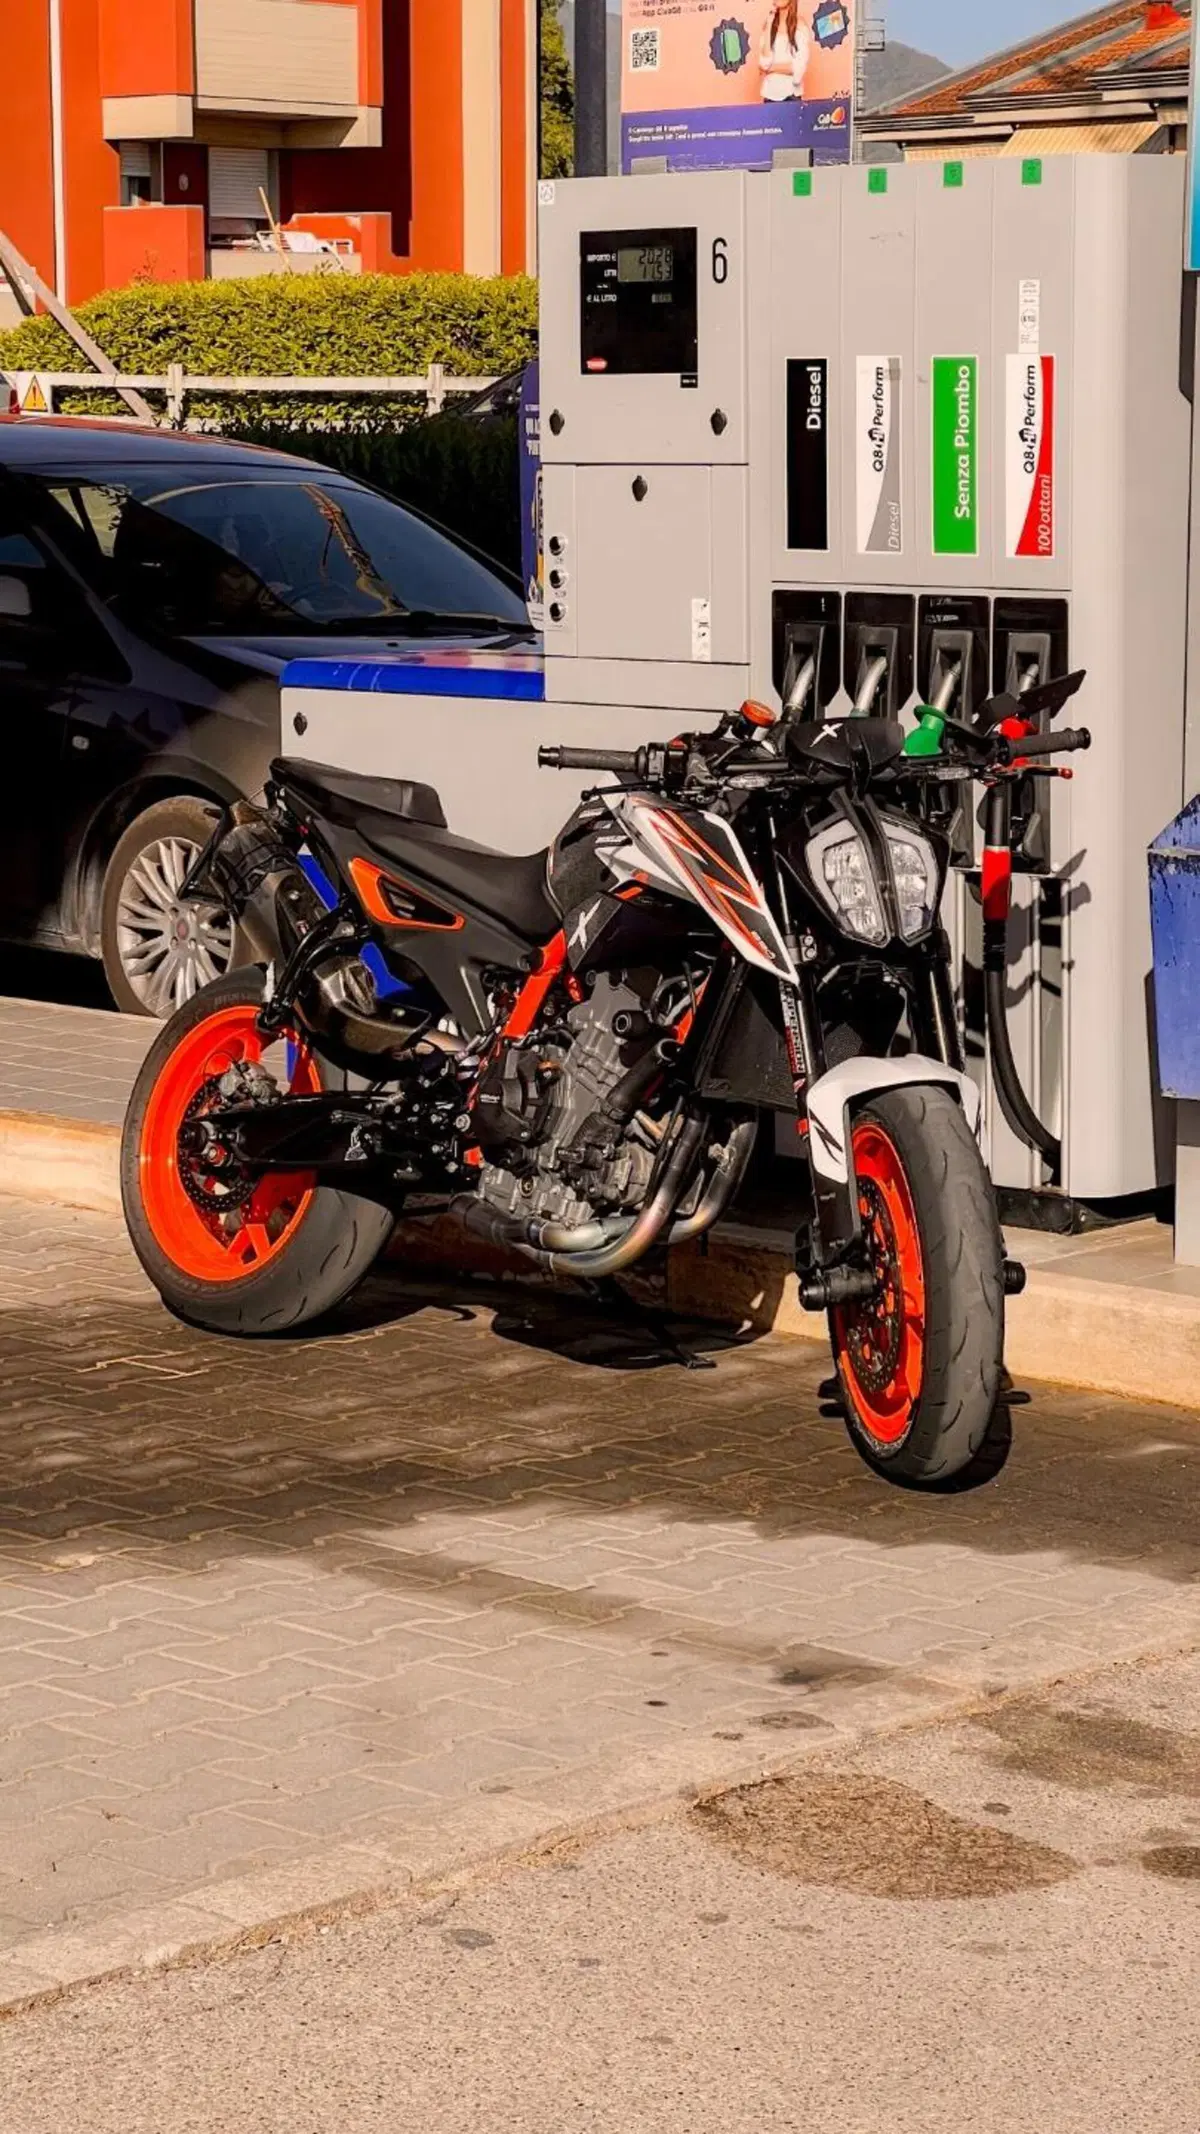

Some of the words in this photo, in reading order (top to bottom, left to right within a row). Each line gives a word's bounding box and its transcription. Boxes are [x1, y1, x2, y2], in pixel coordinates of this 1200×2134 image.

[712, 237, 728, 284] 6
[805, 365, 822, 431] Diesel
[872, 366, 885, 427] Perform
[954, 364, 971, 448] Piombo
[1023, 364, 1036, 427] Perform
[872, 449, 884, 473] Q8
[1023, 450, 1036, 474] Q8
[954, 454, 970, 520] Senza
[1038, 474, 1052, 524] ottani
[887, 501, 899, 550] Diesel
[1038, 524, 1051, 553] 100
